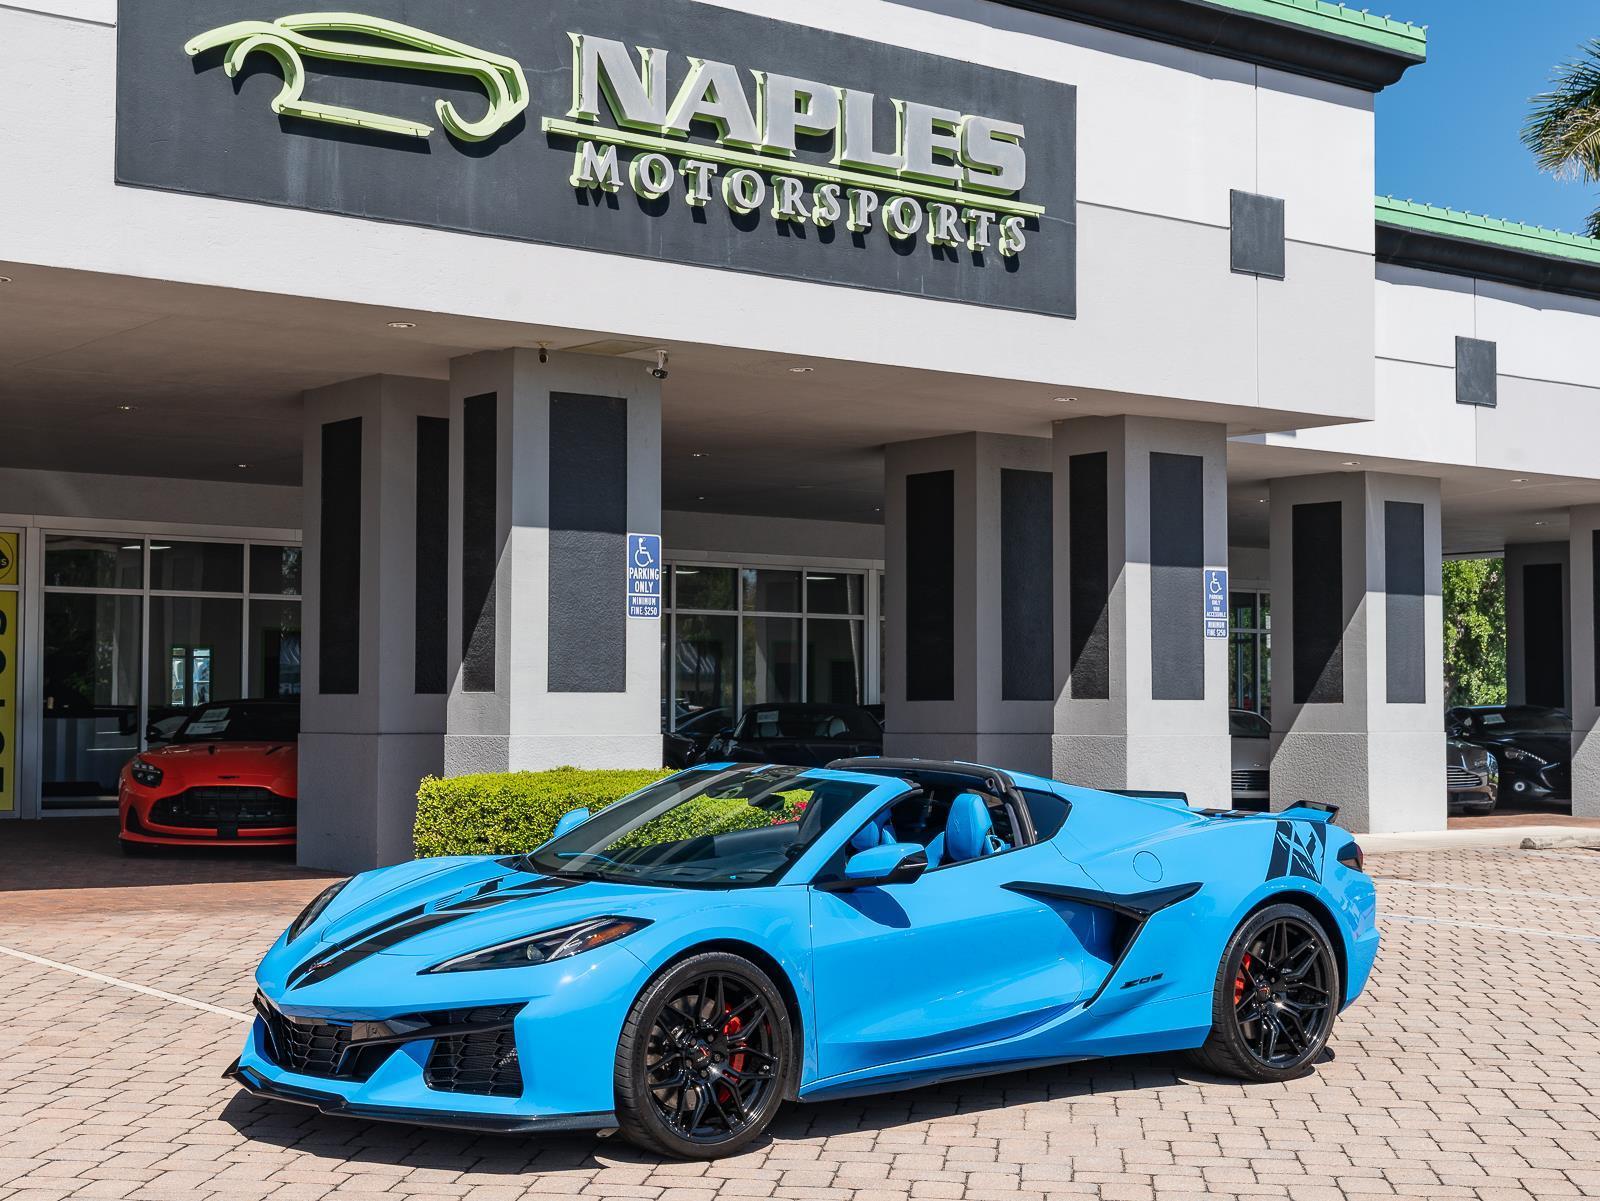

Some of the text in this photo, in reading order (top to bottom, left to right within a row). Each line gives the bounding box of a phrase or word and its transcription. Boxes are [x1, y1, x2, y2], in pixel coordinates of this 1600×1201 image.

[567, 32, 1026, 195] NAPLES
[571, 141, 1026, 257] MOTORSPORTS
[629, 567, 659, 580] PARKING
[635, 581, 653, 593] ONLY
[632, 597, 656, 606] MINIMUM
[630, 606, 657, 615] FINE $250
